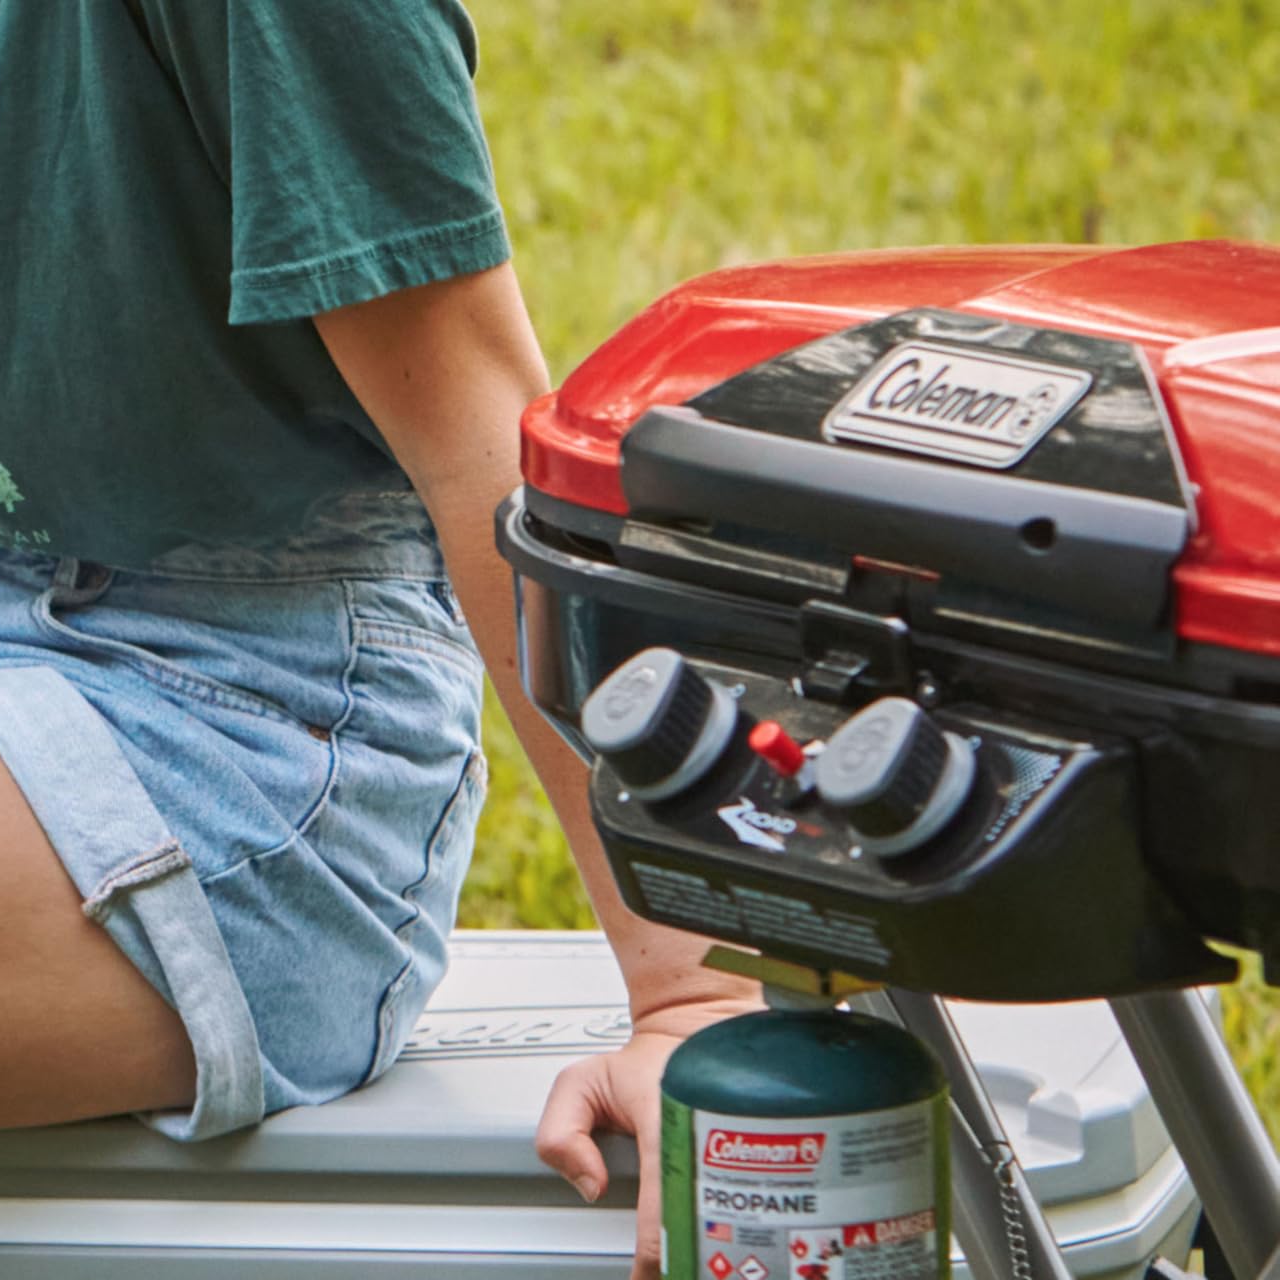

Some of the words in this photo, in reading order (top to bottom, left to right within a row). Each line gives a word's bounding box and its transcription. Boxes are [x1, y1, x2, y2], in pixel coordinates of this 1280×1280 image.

[868, 357, 1019, 430] Coleman
[708, 1131, 798, 1162] Coleman
[703, 1187, 818, 1214] PROPANE
